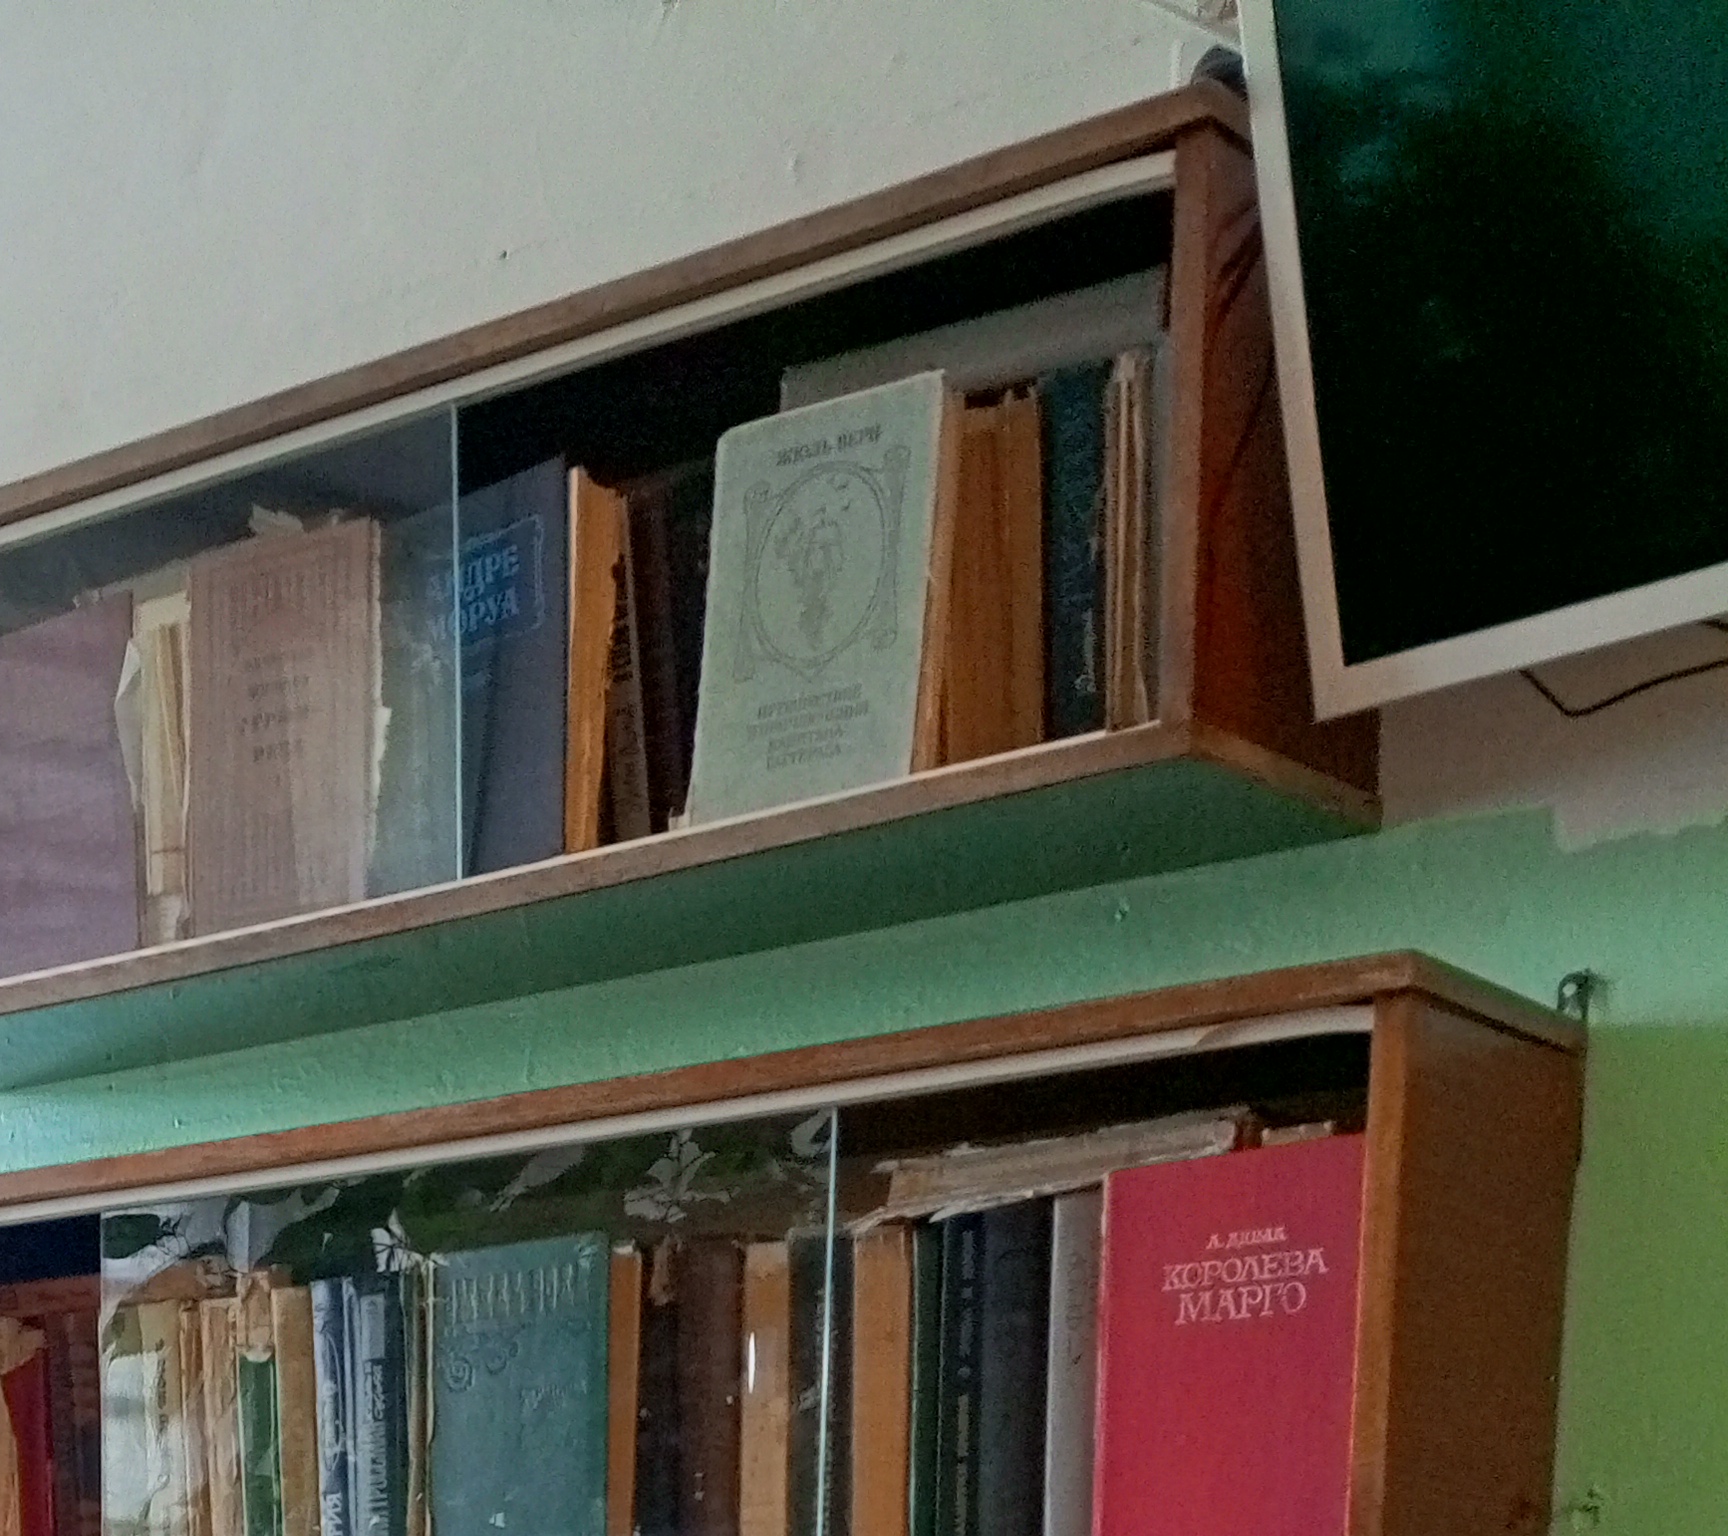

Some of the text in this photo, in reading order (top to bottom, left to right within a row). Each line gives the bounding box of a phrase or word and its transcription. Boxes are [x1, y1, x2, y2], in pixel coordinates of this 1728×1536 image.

[1226, 1226, 1288, 1250] ДЮМА
[1161, 1247, 1330, 1292] КОРОЛЕВА
[1174, 1281, 1308, 1326] МАРГО
